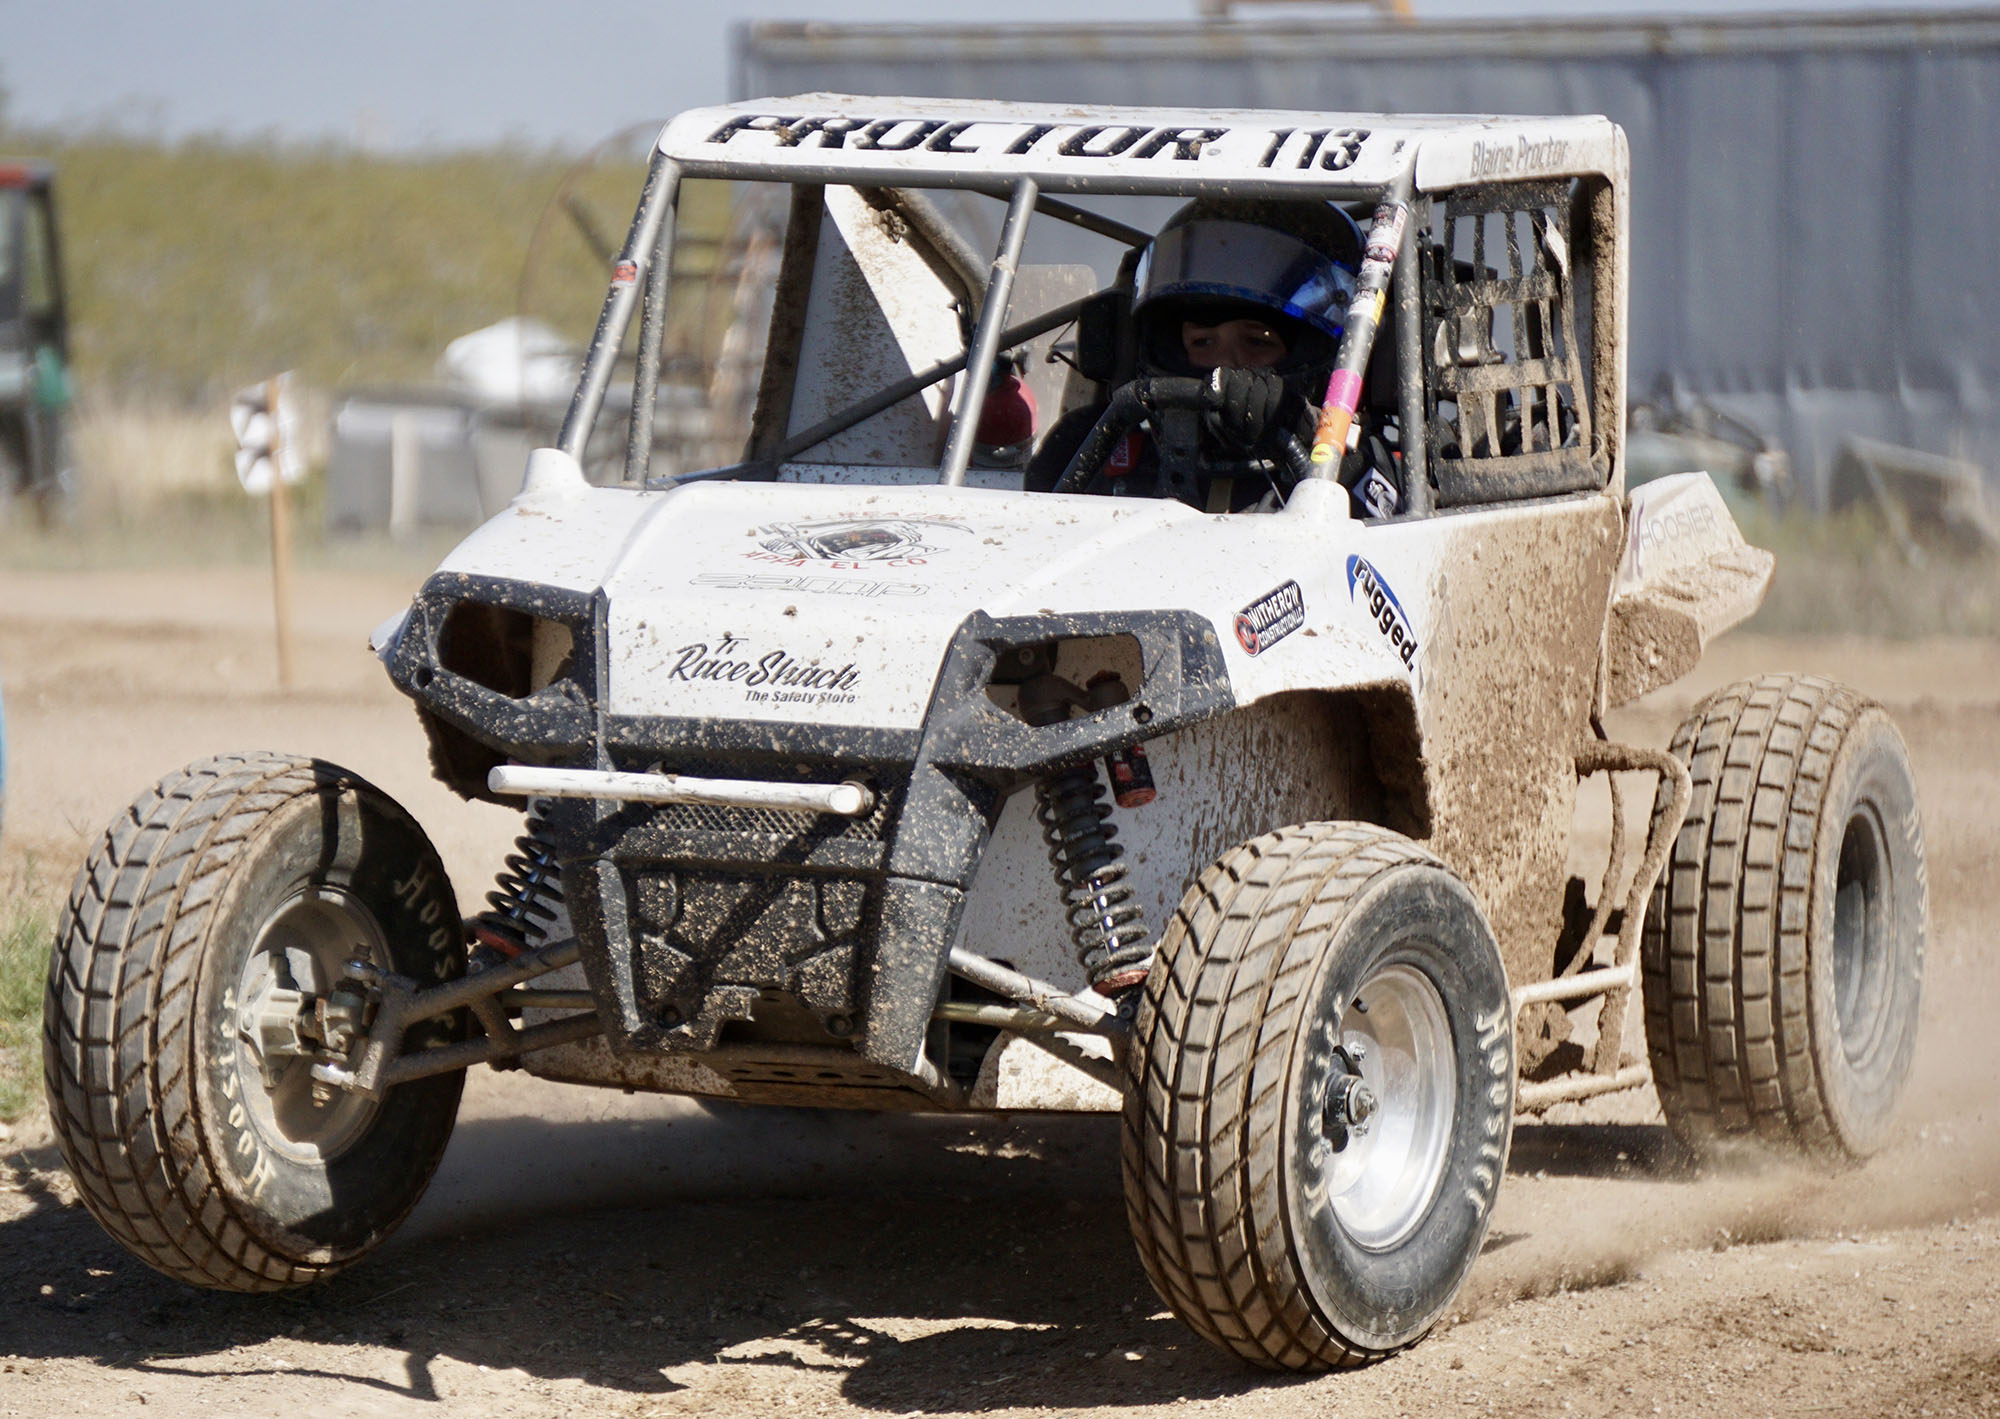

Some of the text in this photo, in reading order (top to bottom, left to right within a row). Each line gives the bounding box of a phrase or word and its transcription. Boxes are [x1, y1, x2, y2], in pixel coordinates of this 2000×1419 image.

[704, 114, 1372, 171] PROCTOR 113
[1470, 134, 1569, 178] Blaine Proctor
[1640, 504, 1718, 551] HOOSIER
[1247, 582, 1300, 632] WITHEROW
[745, 690, 856, 704] The Safety Store
